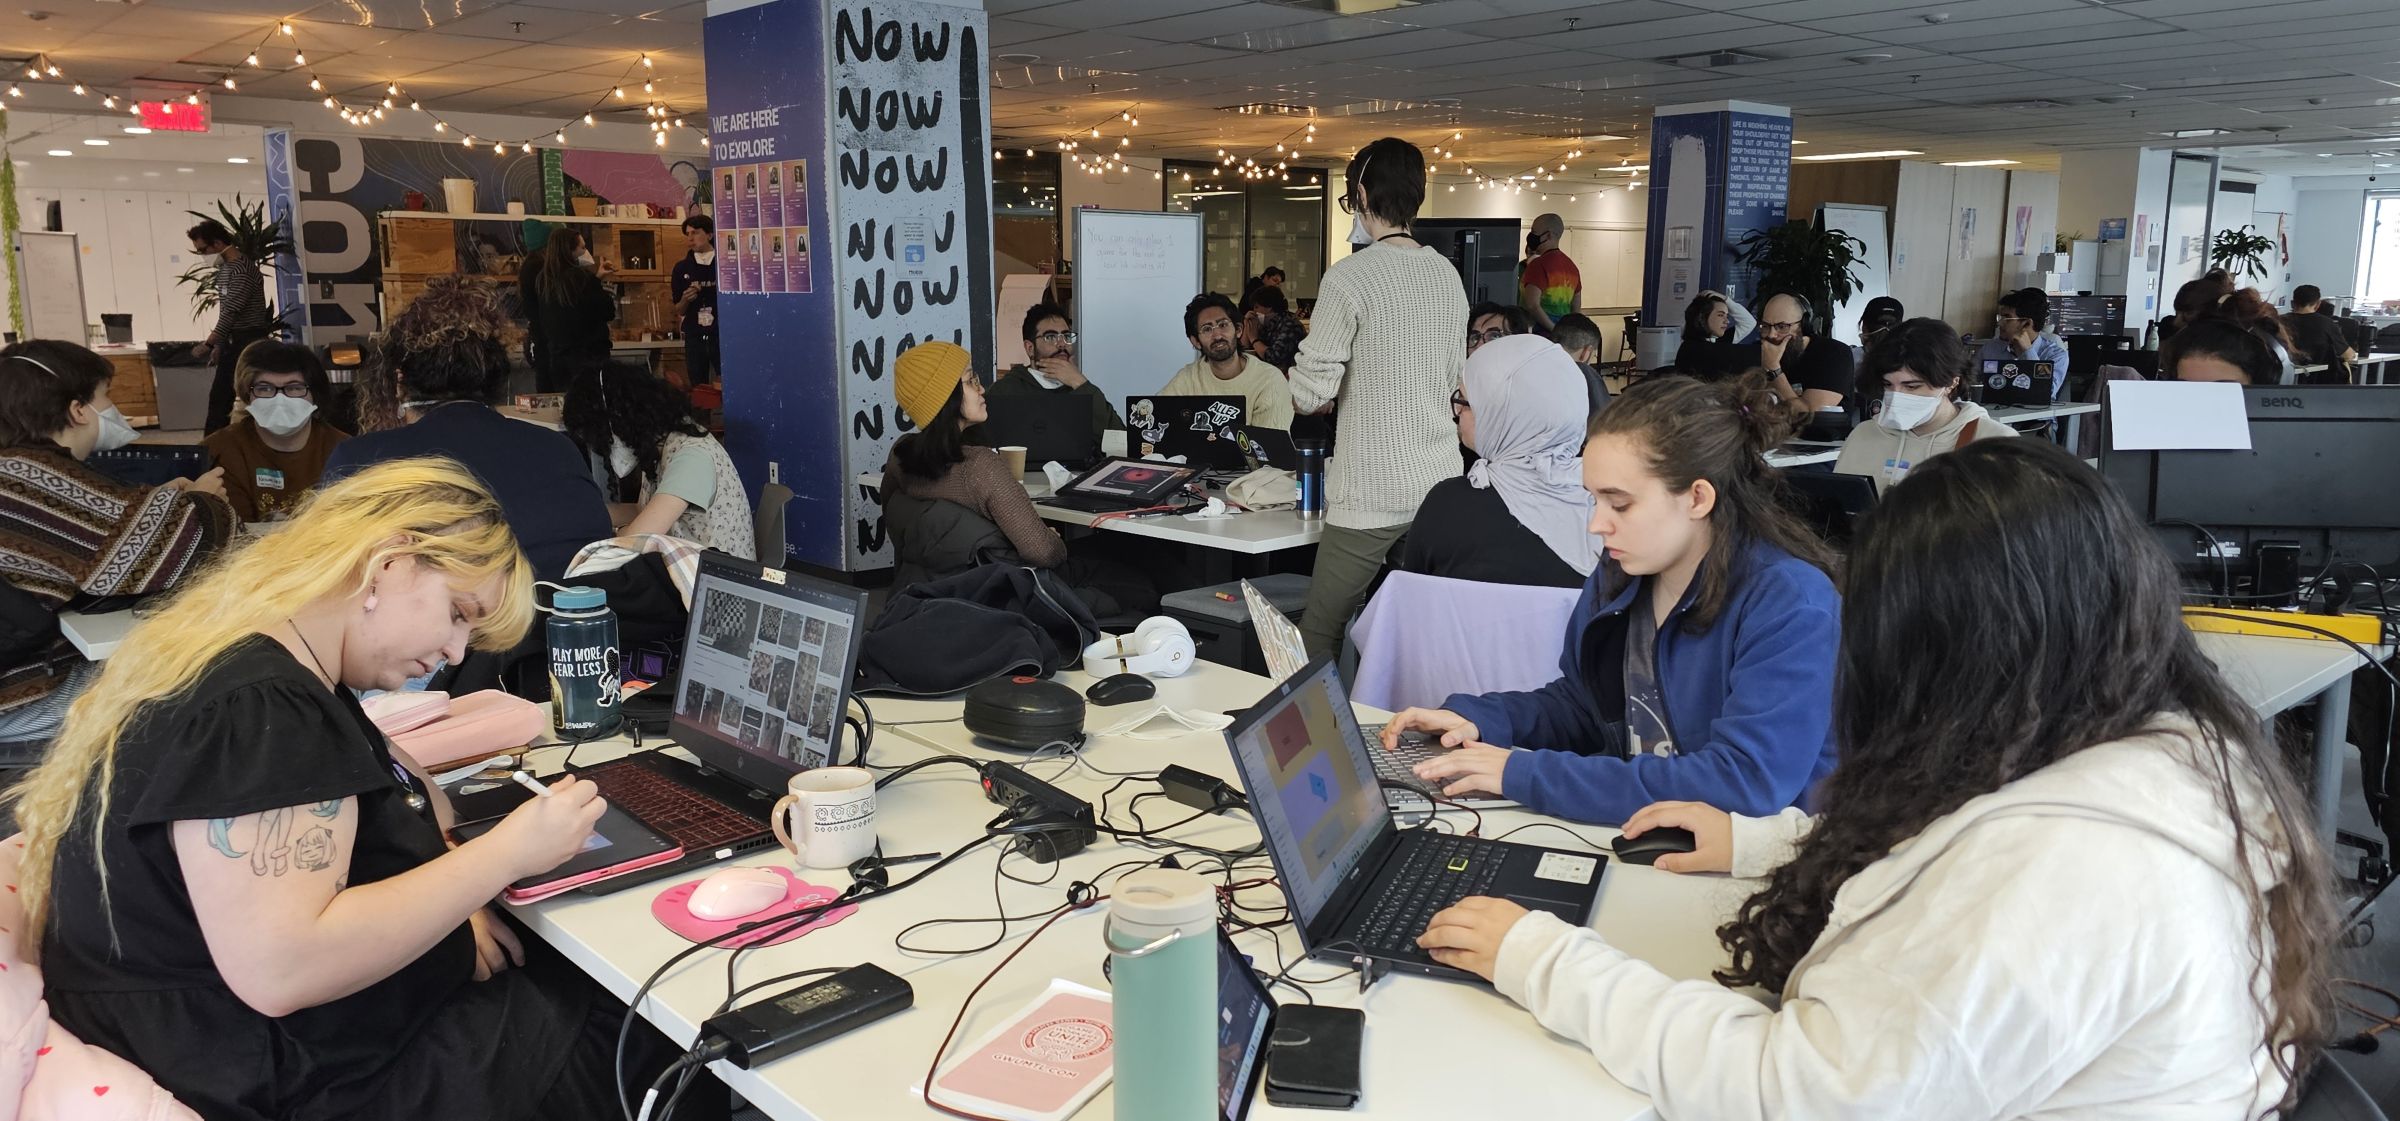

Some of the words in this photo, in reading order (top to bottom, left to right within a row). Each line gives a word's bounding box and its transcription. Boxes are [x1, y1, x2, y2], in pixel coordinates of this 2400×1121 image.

[713, 116, 728, 133] WE
[730, 112, 749, 131] ARE
[751, 108, 779, 129] HERE
[714, 144, 727, 160] TO
[729, 138, 775, 160] EXPLORE
[1210, 402, 1239, 417] ALLEZ
[2261, 397, 2304, 409] BenQ
[1214, 413, 1228, 425] UP
[553, 648, 571, 662] PLAY
[575, 646, 603, 661] MORE.
[554, 663, 575, 677] FEAR
[577, 661, 604, 677] LESS.
[1048, 1030, 1091, 1045] UNITE
